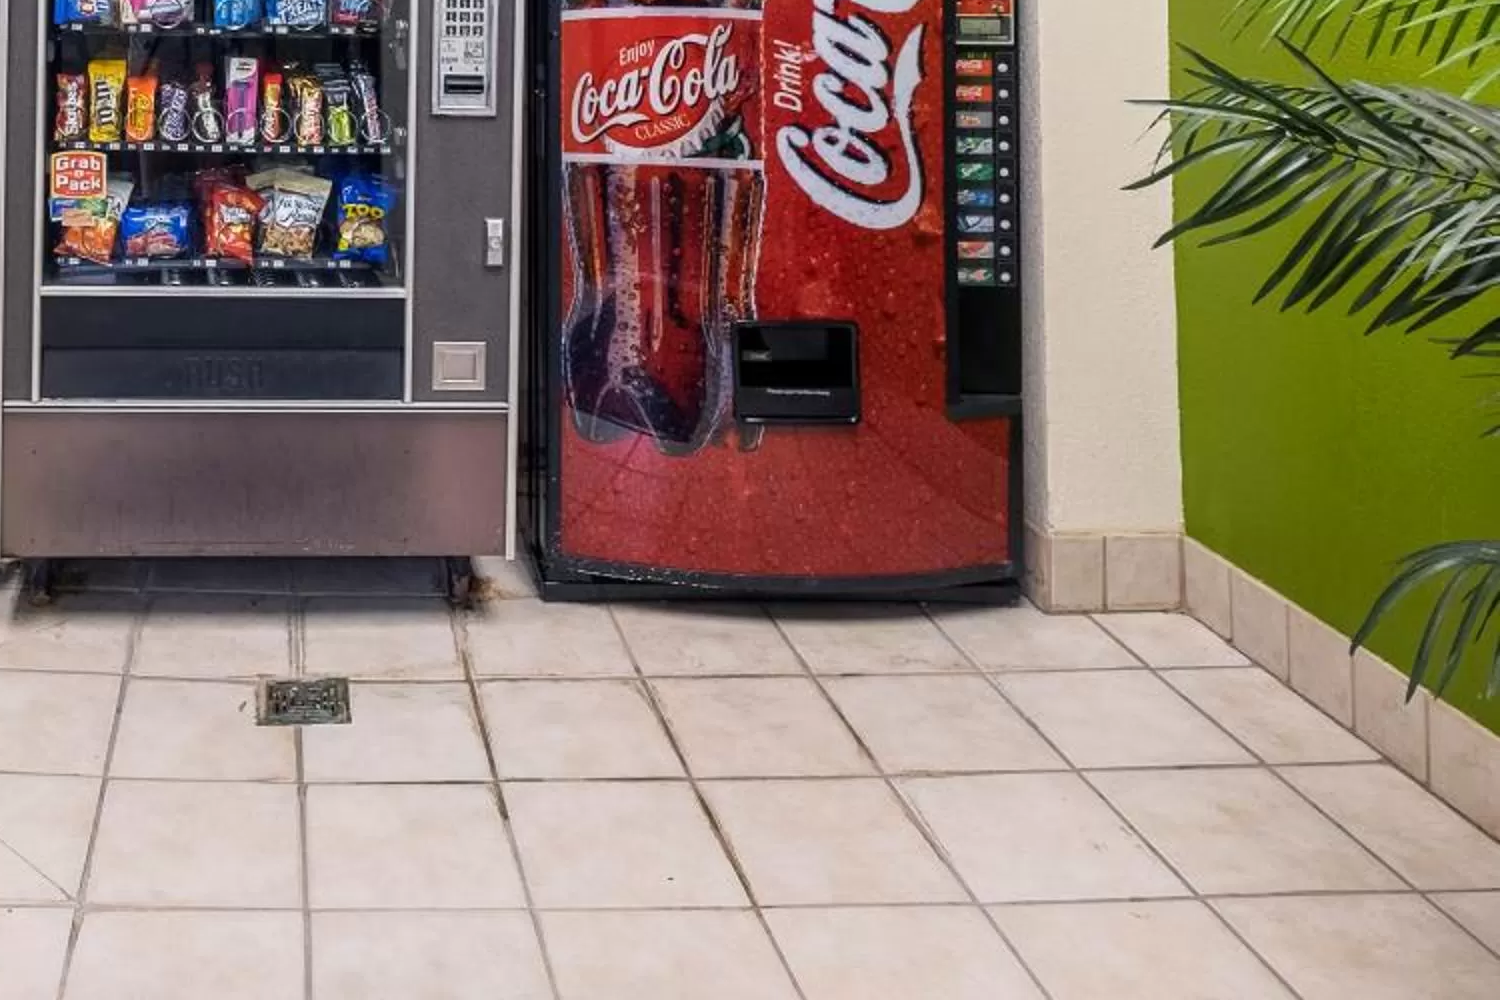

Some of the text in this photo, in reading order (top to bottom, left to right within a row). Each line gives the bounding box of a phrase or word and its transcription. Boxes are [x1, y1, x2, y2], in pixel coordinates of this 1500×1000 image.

[619, 39, 655, 67] Enjoy
[571, 20, 739, 143] Coca-Cola
[773, 40, 803, 112] Drink!
[634, 113, 691, 141] CLASSIC
[55, 156, 101, 171] Grab
[55, 173, 101, 191] Pack
